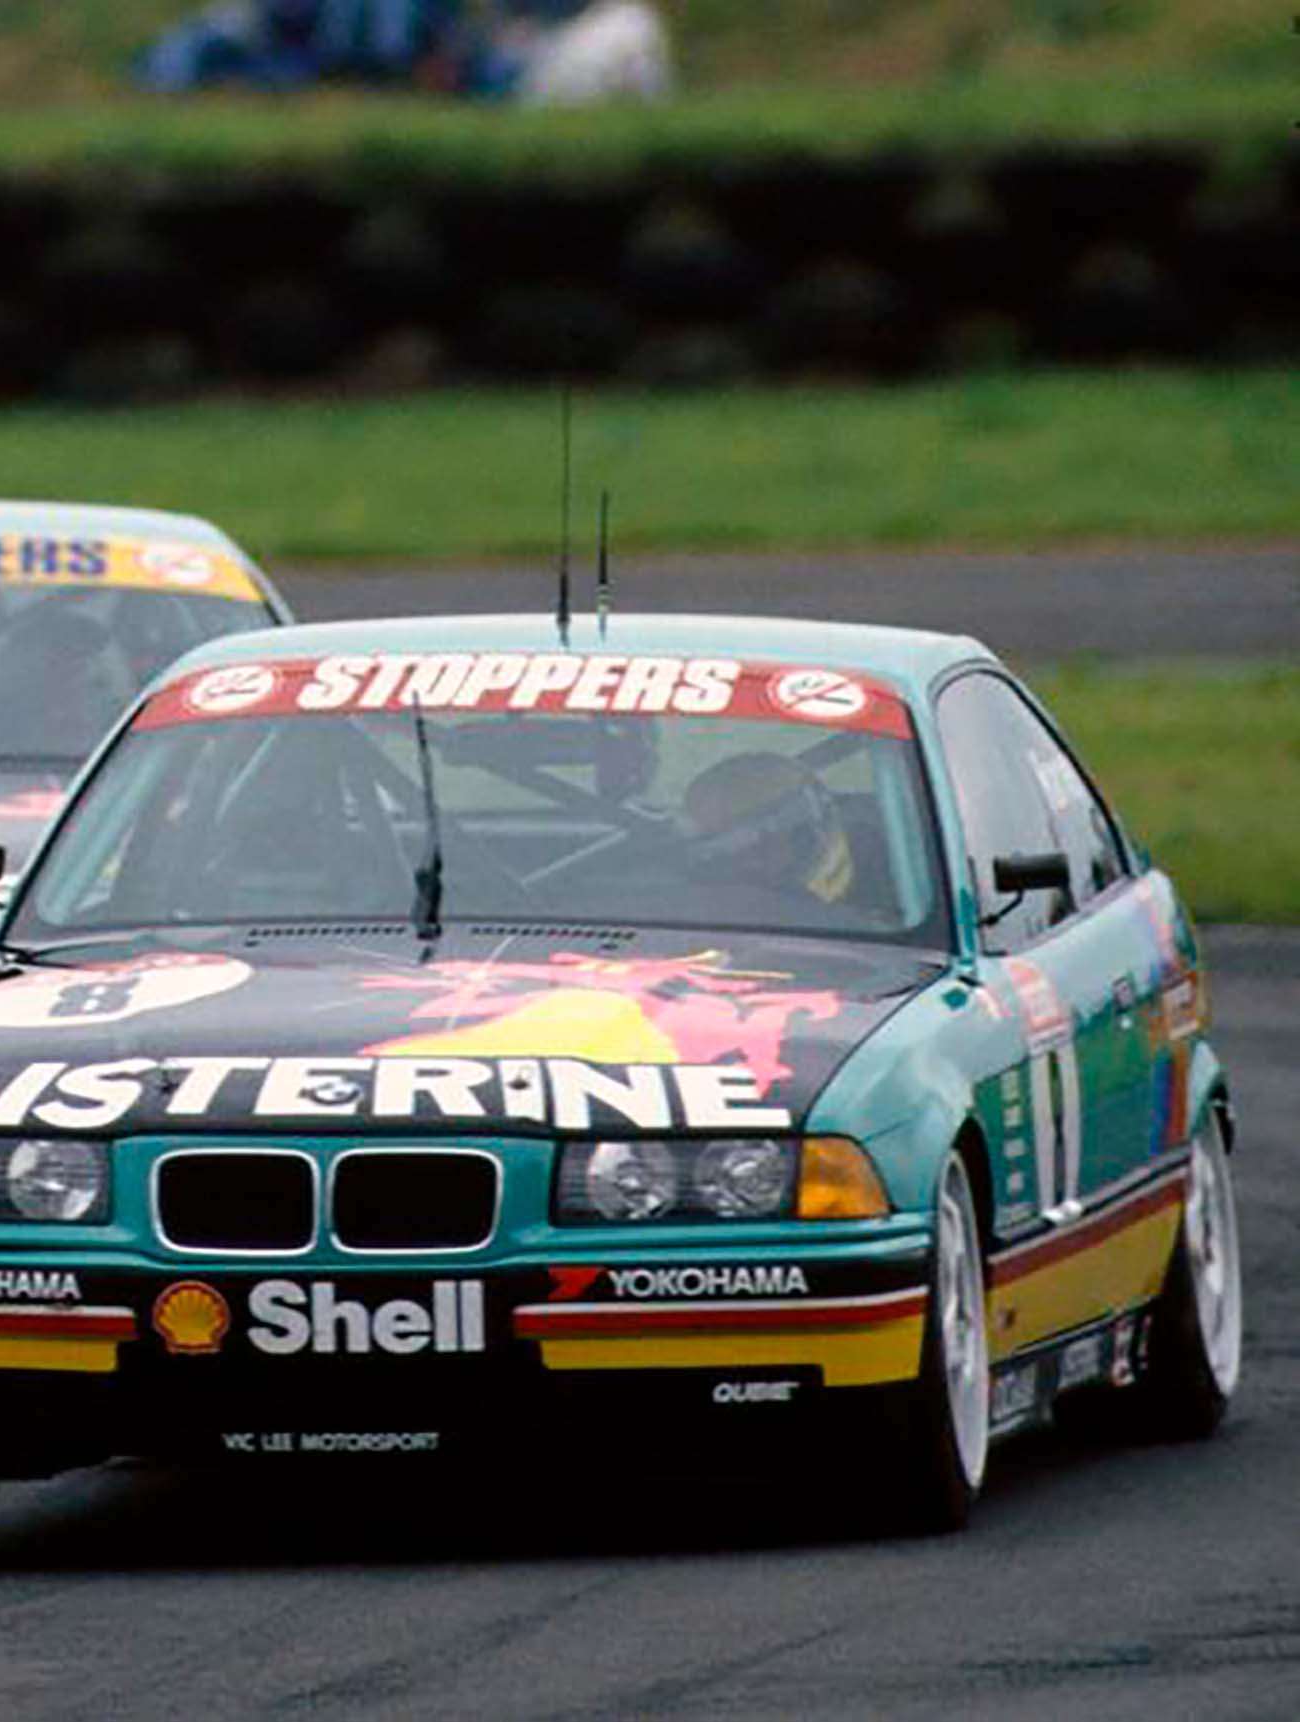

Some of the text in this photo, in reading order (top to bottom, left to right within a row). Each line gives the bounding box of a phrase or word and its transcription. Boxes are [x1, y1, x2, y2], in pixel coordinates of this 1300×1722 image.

[296, 653, 741, 713] STOPPERS
[48, 976, 141, 1019] 8
[608, 1266, 809, 1298] YOKOHAMA
[247, 1279, 485, 1355] Shell
[222, 1431, 439, 1452] VIC LEE MOTORSPORT
